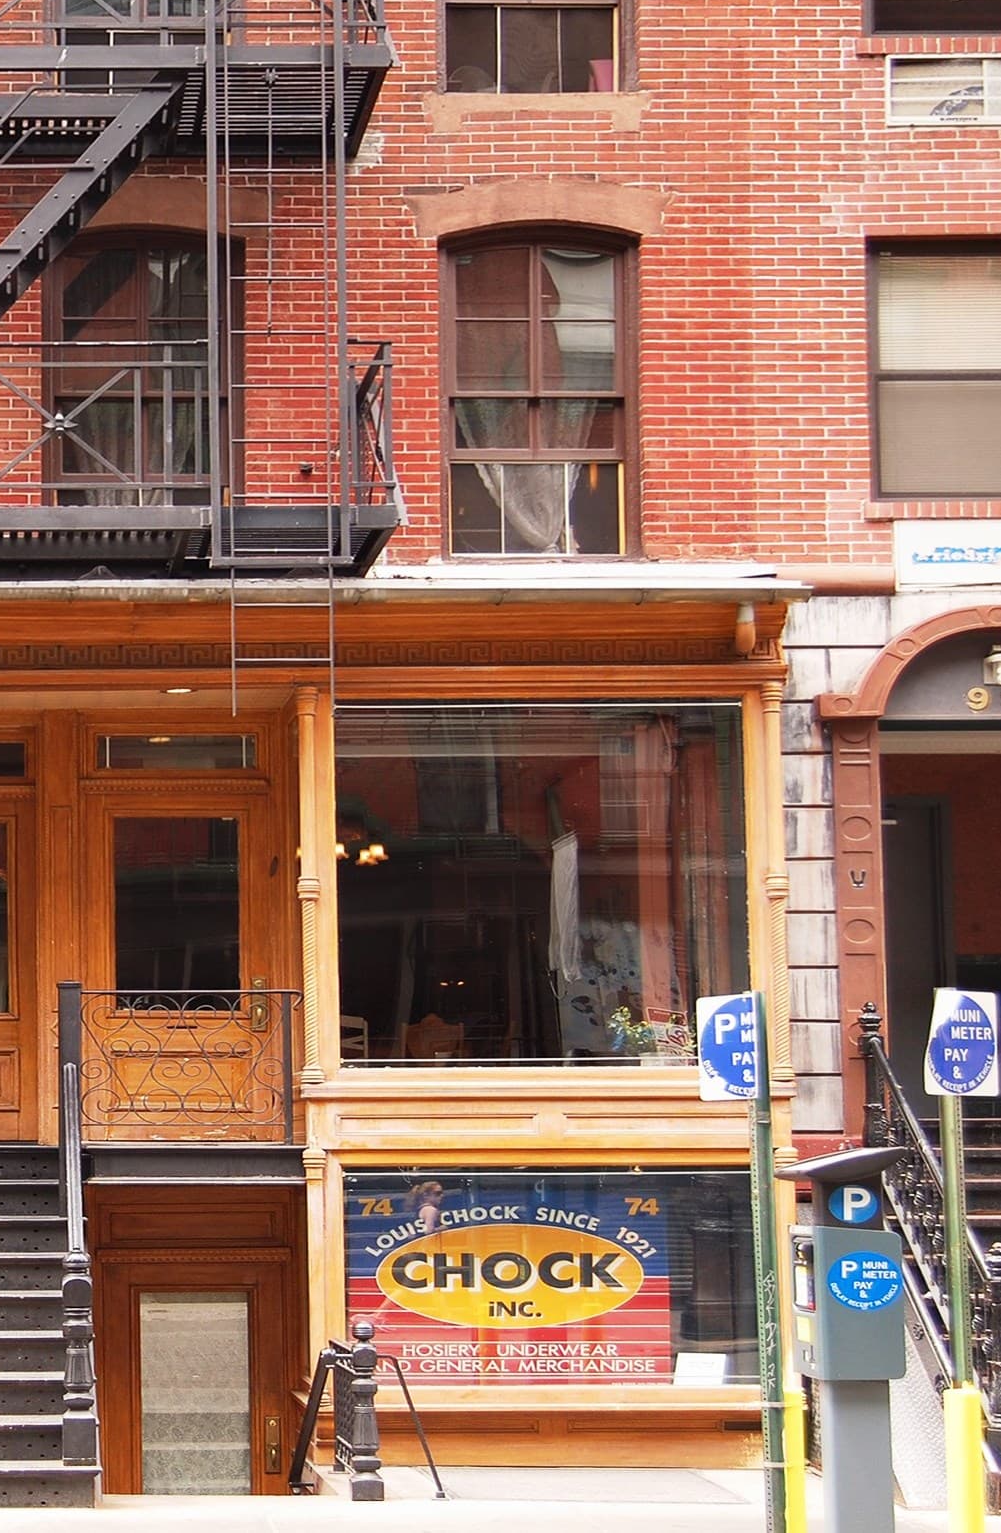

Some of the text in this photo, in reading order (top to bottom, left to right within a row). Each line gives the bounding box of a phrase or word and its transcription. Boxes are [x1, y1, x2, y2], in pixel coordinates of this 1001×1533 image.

[967, 687, 989, 711] 9
[950, 1009, 981, 1023] MUNI
[714, 1013, 737, 1045] P
[951, 1026, 993, 1041] METER
[944, 1048, 969, 1062] PAY
[742, 1068, 755, 1083] &
[953, 1065, 963, 1079] &
[357, 1197, 394, 1216] 74
[624, 1197, 660, 1216] 74
[843, 1187, 872, 1221] P
[365, 1205, 657, 1259] LOUIS CHOCK SINCE 1921
[391, 1251, 627, 1292] CHOCK
[841, 1260, 858, 1279] P
[862, 1260, 888, 1270] MUNI
[862, 1270, 897, 1280] METER
[853, 1281, 873, 1290] PAY
[859, 1289, 869, 1299] &
[402, 1344, 618, 1357] HOSIERY UNDERWEAR
[419, 1359, 510, 1373] GENERAL
[518, 1359, 656, 1373] MERCHANDISE
